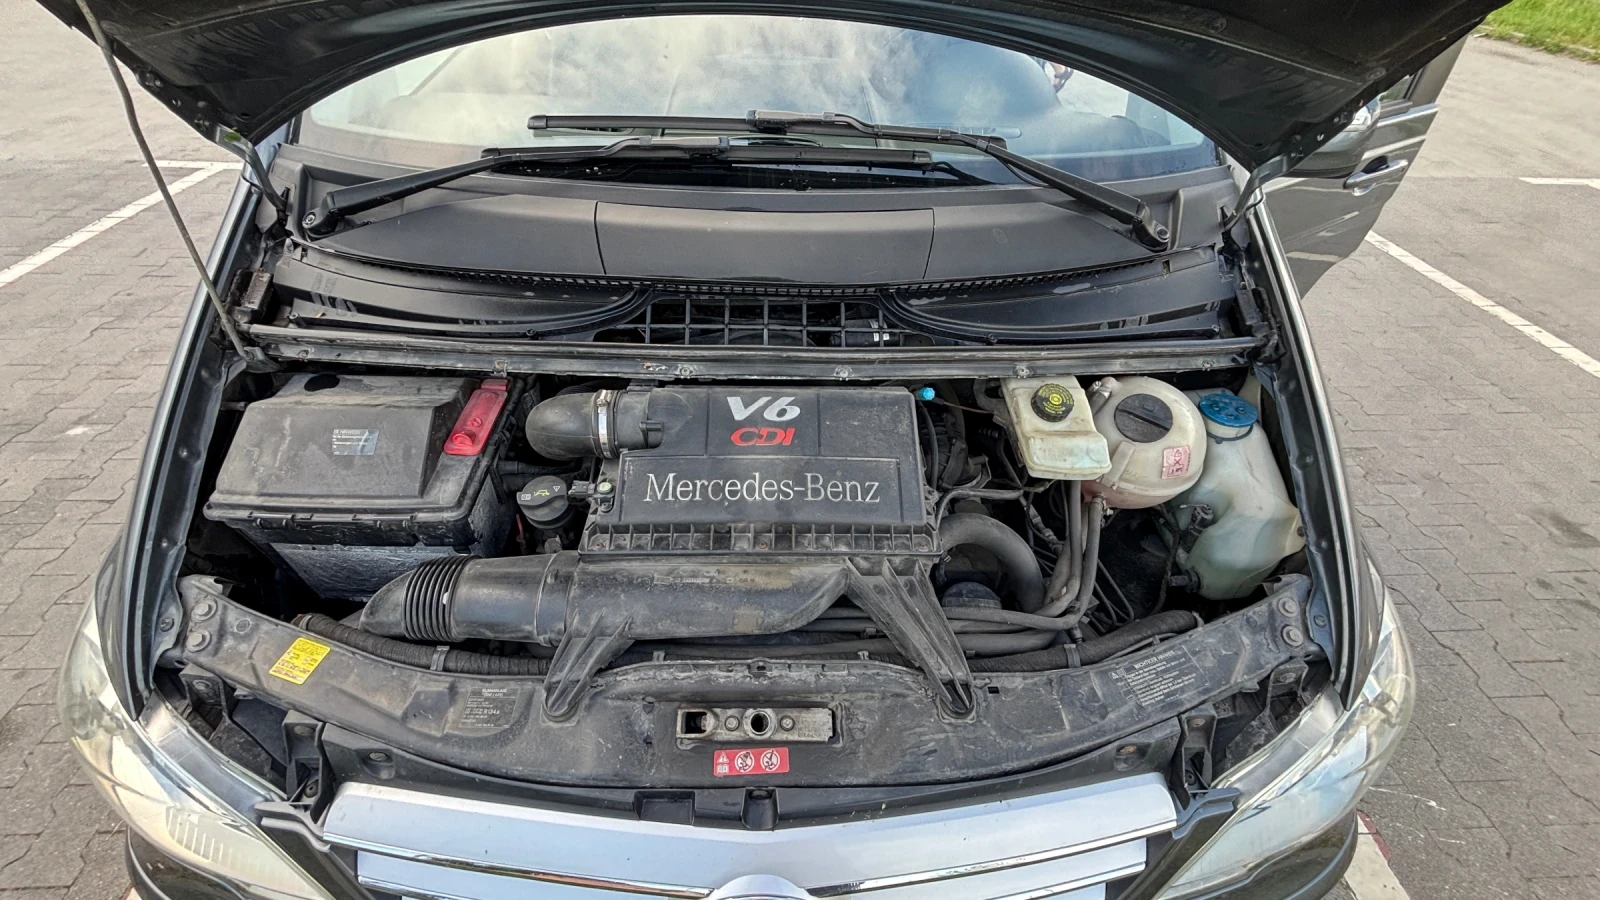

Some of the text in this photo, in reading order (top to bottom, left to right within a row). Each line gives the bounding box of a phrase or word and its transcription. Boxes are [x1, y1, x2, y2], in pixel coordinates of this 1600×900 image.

[726, 396, 801, 421] V6
[730, 427, 796, 446] CDI
[643, 472, 881, 503] Mercedes-Benz
